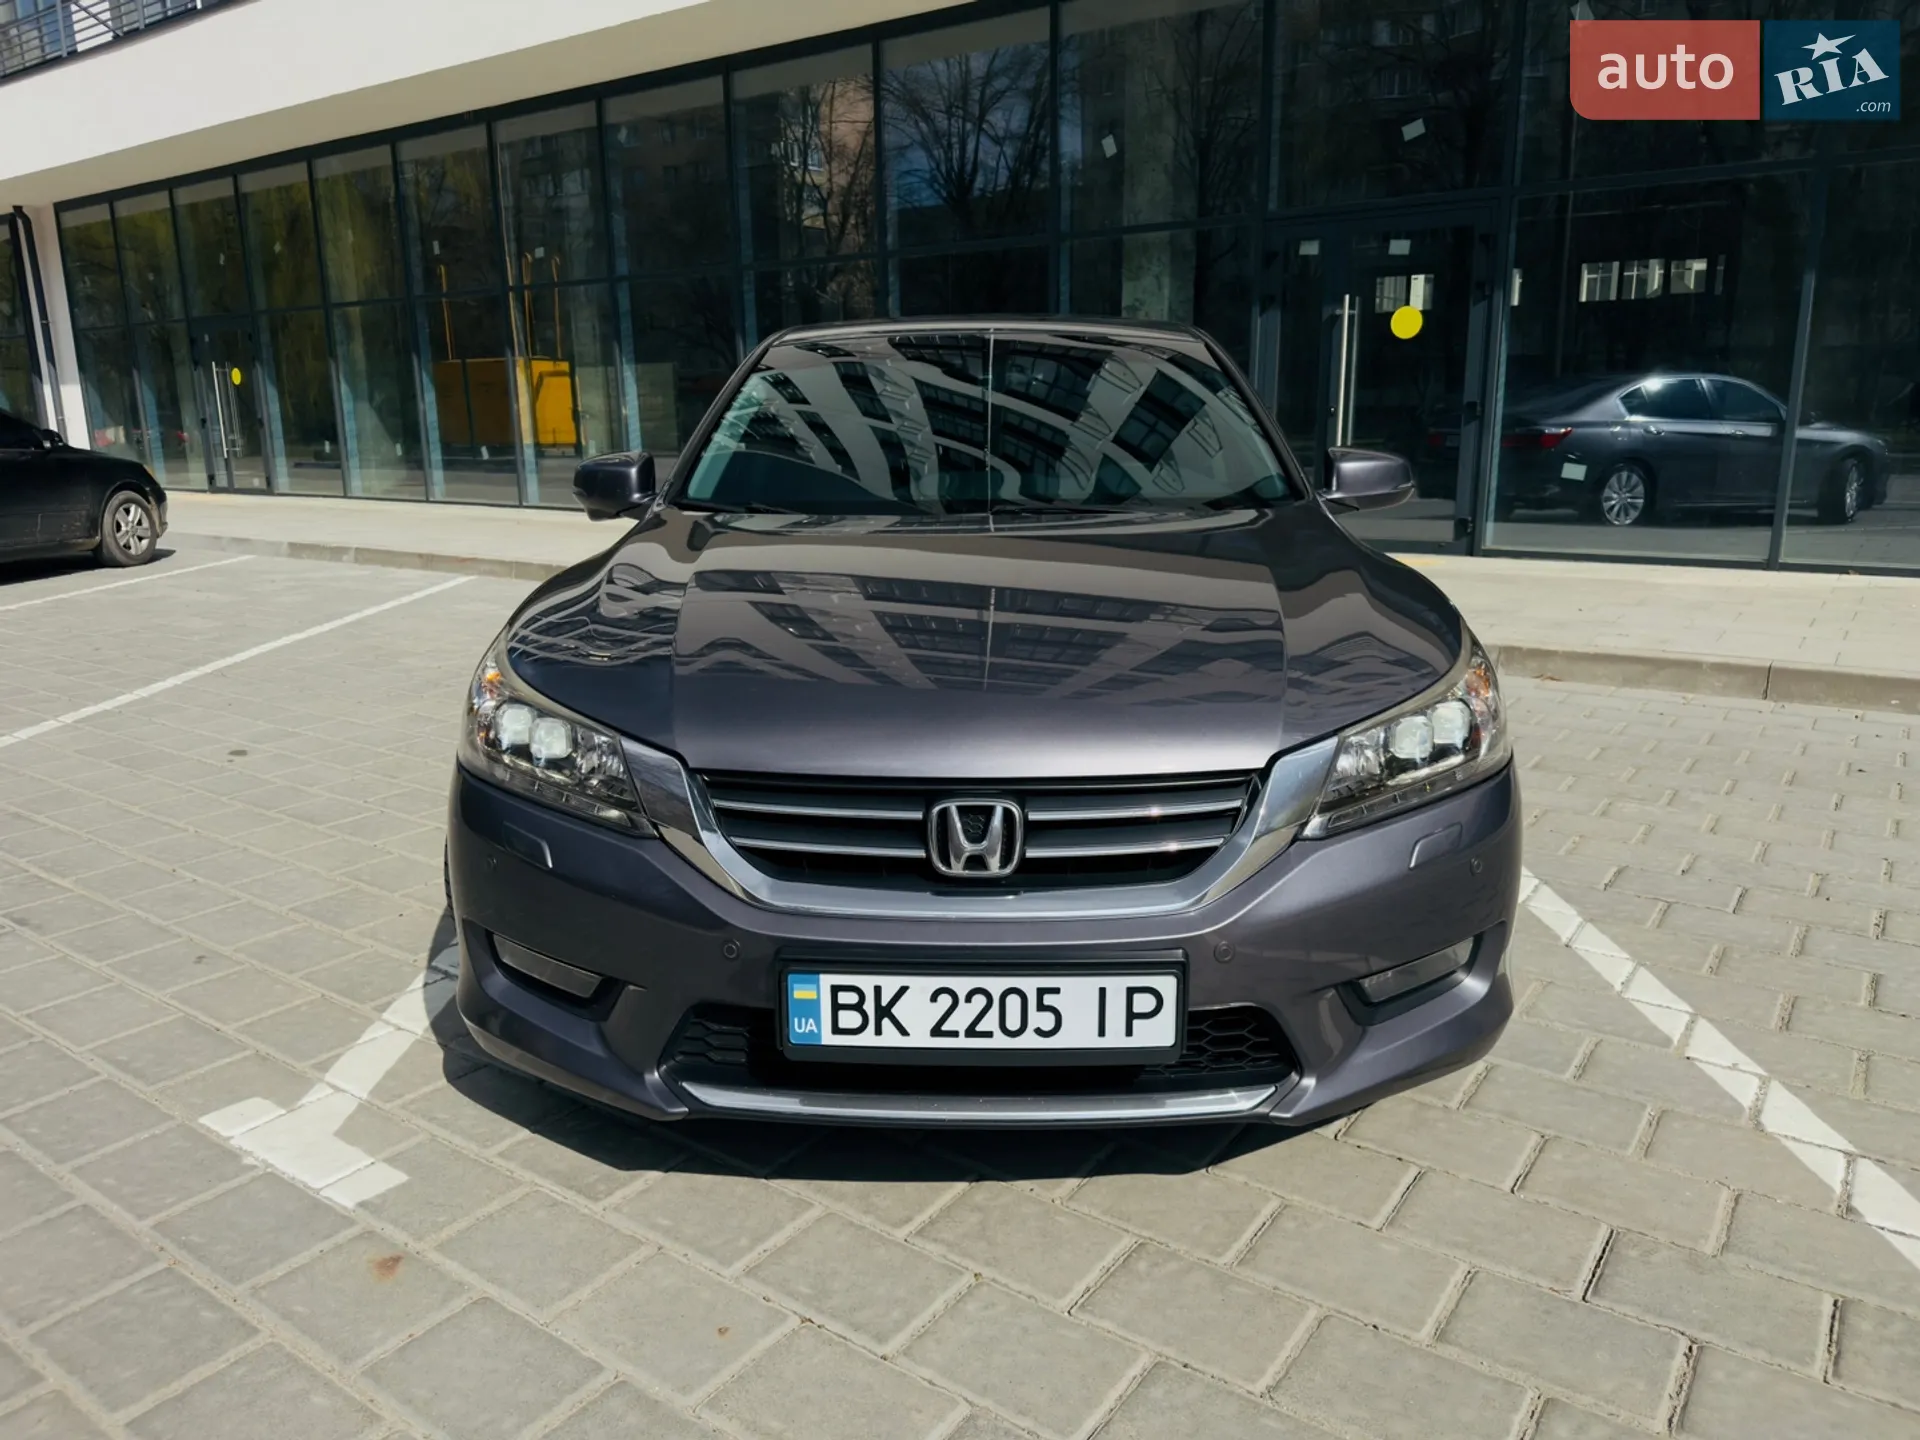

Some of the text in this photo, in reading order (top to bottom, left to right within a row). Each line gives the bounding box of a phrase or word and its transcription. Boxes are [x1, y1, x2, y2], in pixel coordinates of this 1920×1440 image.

[793, 1017, 818, 1034] UA
[829, 984, 1164, 1039] BK 2205 IP
